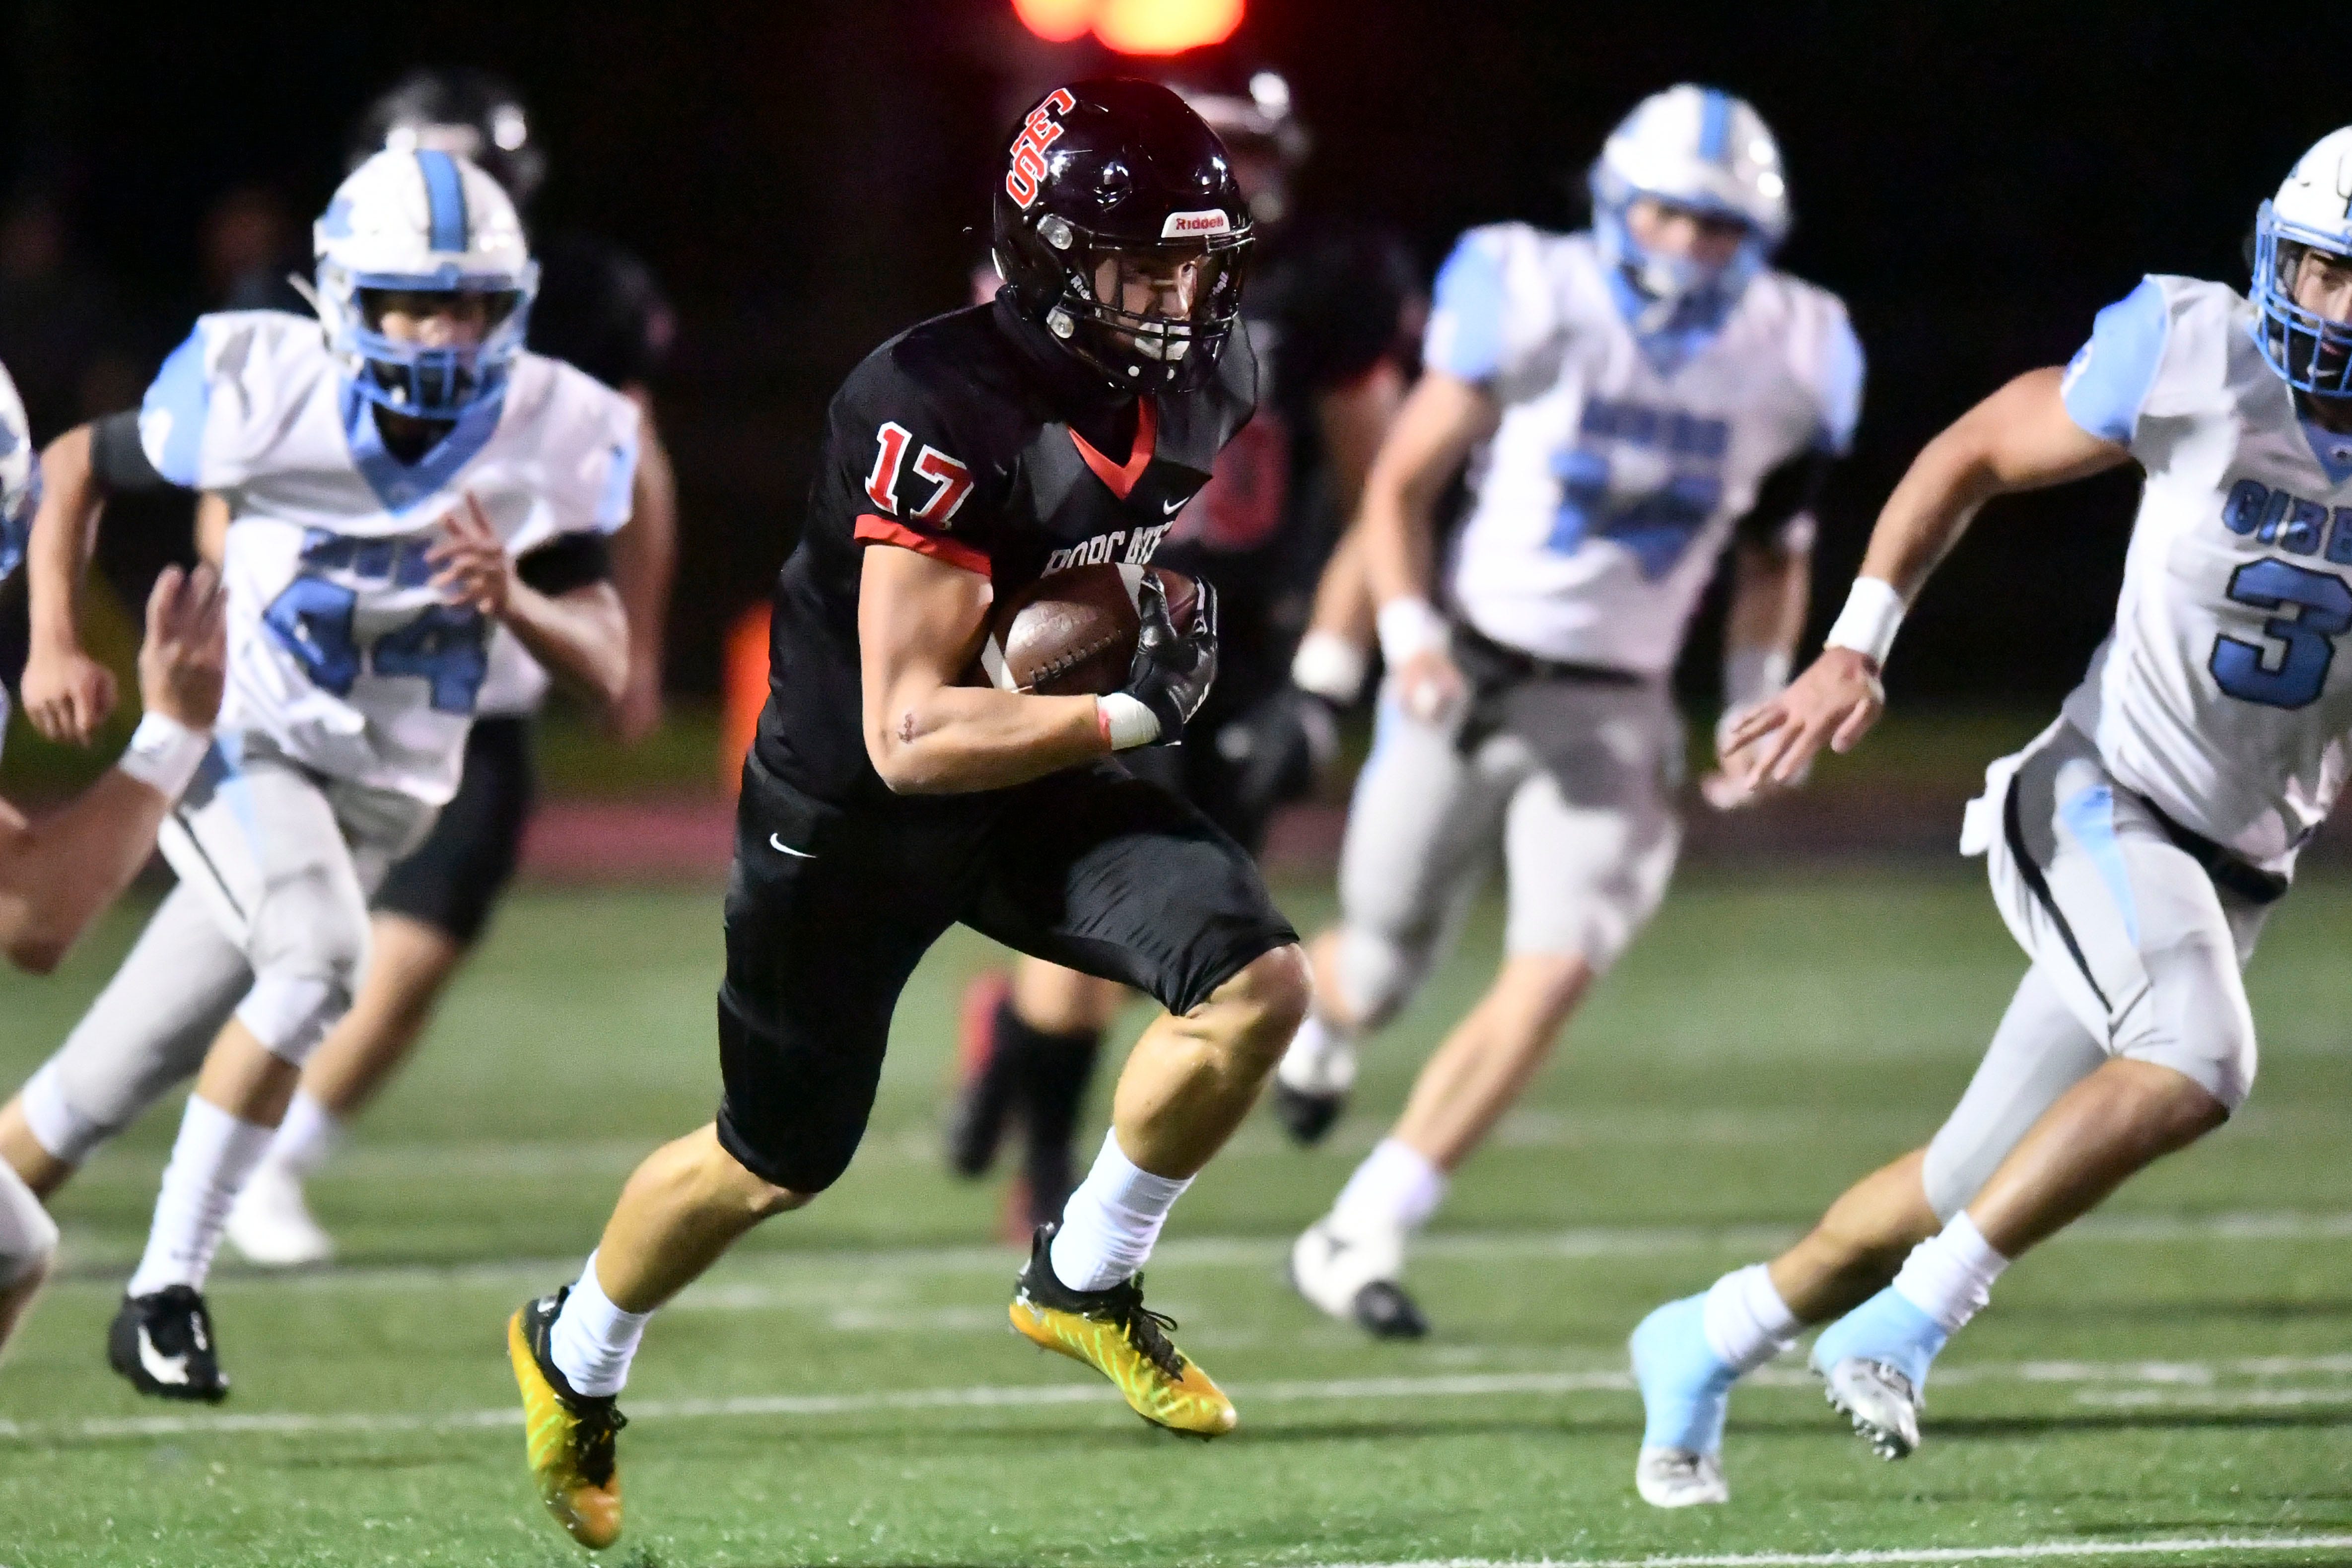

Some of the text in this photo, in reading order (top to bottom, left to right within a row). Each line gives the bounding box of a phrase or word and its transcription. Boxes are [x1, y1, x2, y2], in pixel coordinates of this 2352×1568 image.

[1176, 215, 1224, 230] Riddell
[865, 421, 974, 531] 17
[2209, 556, 2352, 710] 3
